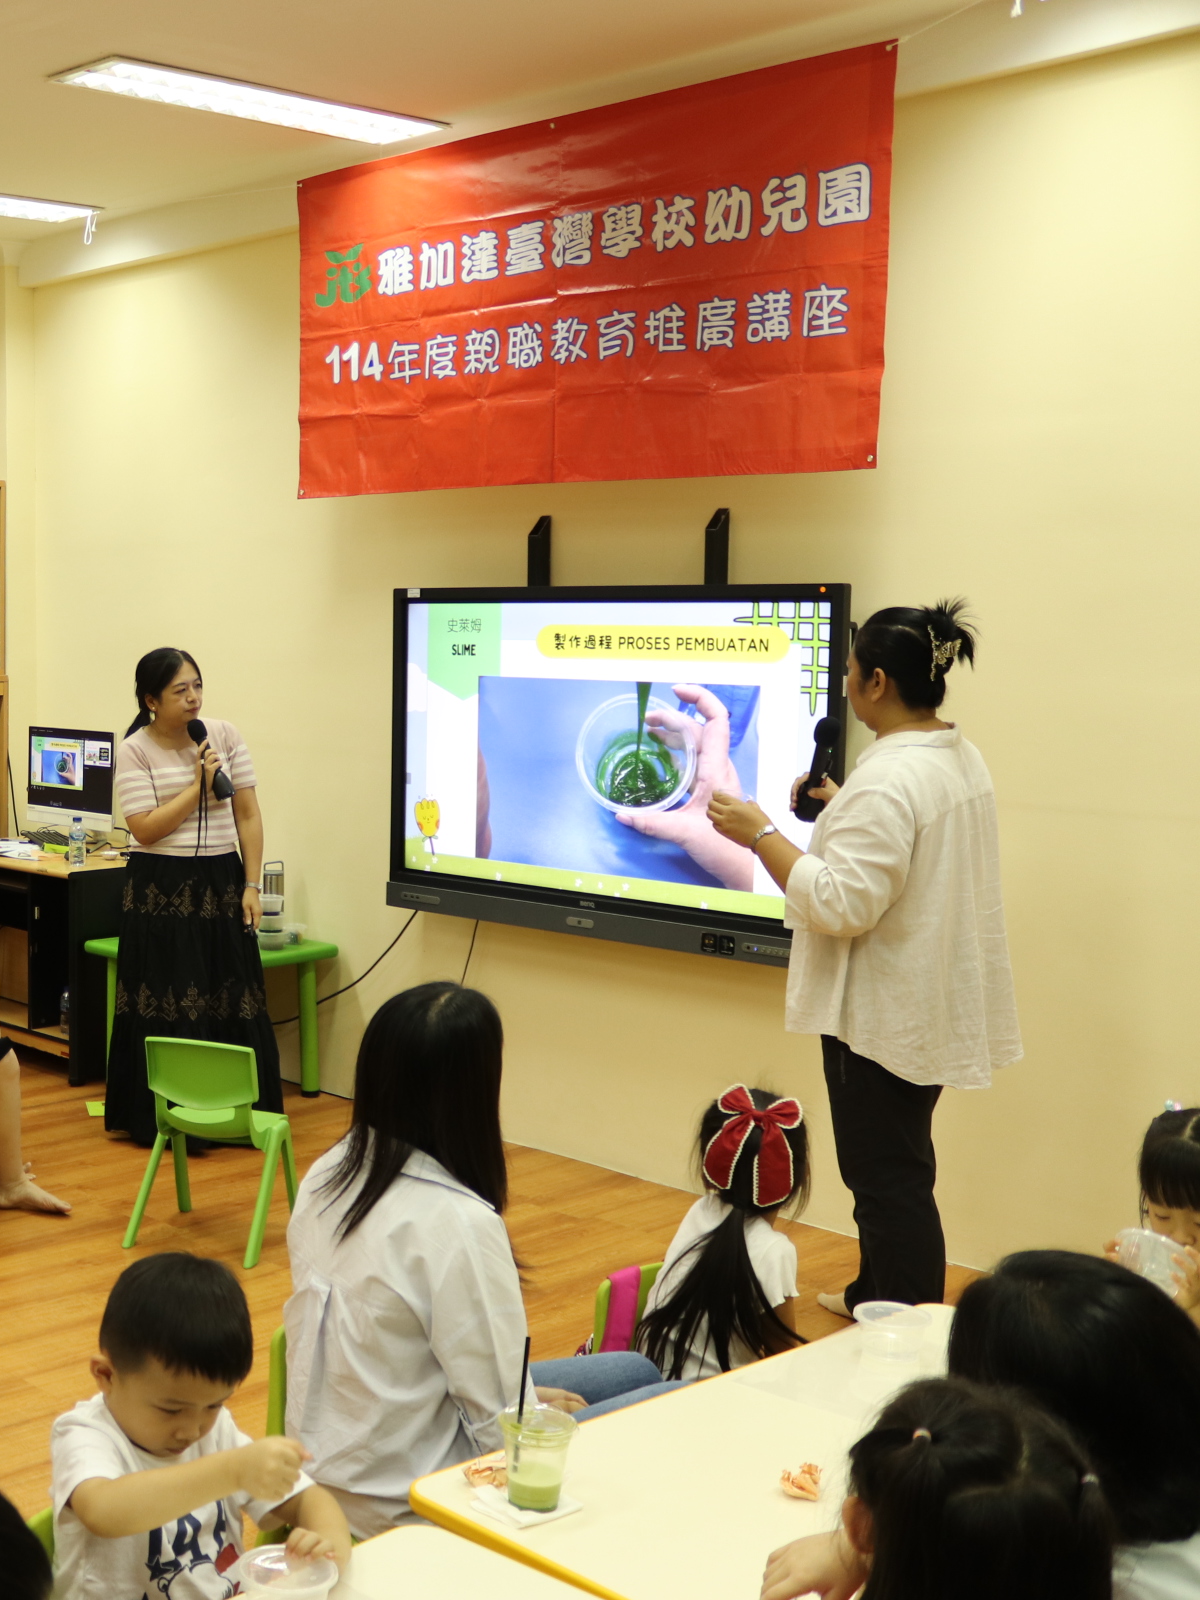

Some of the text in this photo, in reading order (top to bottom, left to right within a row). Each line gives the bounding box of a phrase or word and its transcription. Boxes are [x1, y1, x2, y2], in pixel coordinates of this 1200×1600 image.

[377, 162, 871, 296] 雅加達臺灣學校幼兒園
[325, 284, 848, 385] 114年度親職教育推廣講座
[447, 617, 482, 634] 史萊姆
[451, 643, 477, 656] SLIME
[554, 632, 770, 653] 製作過程 PROSES PEMBUATAN
